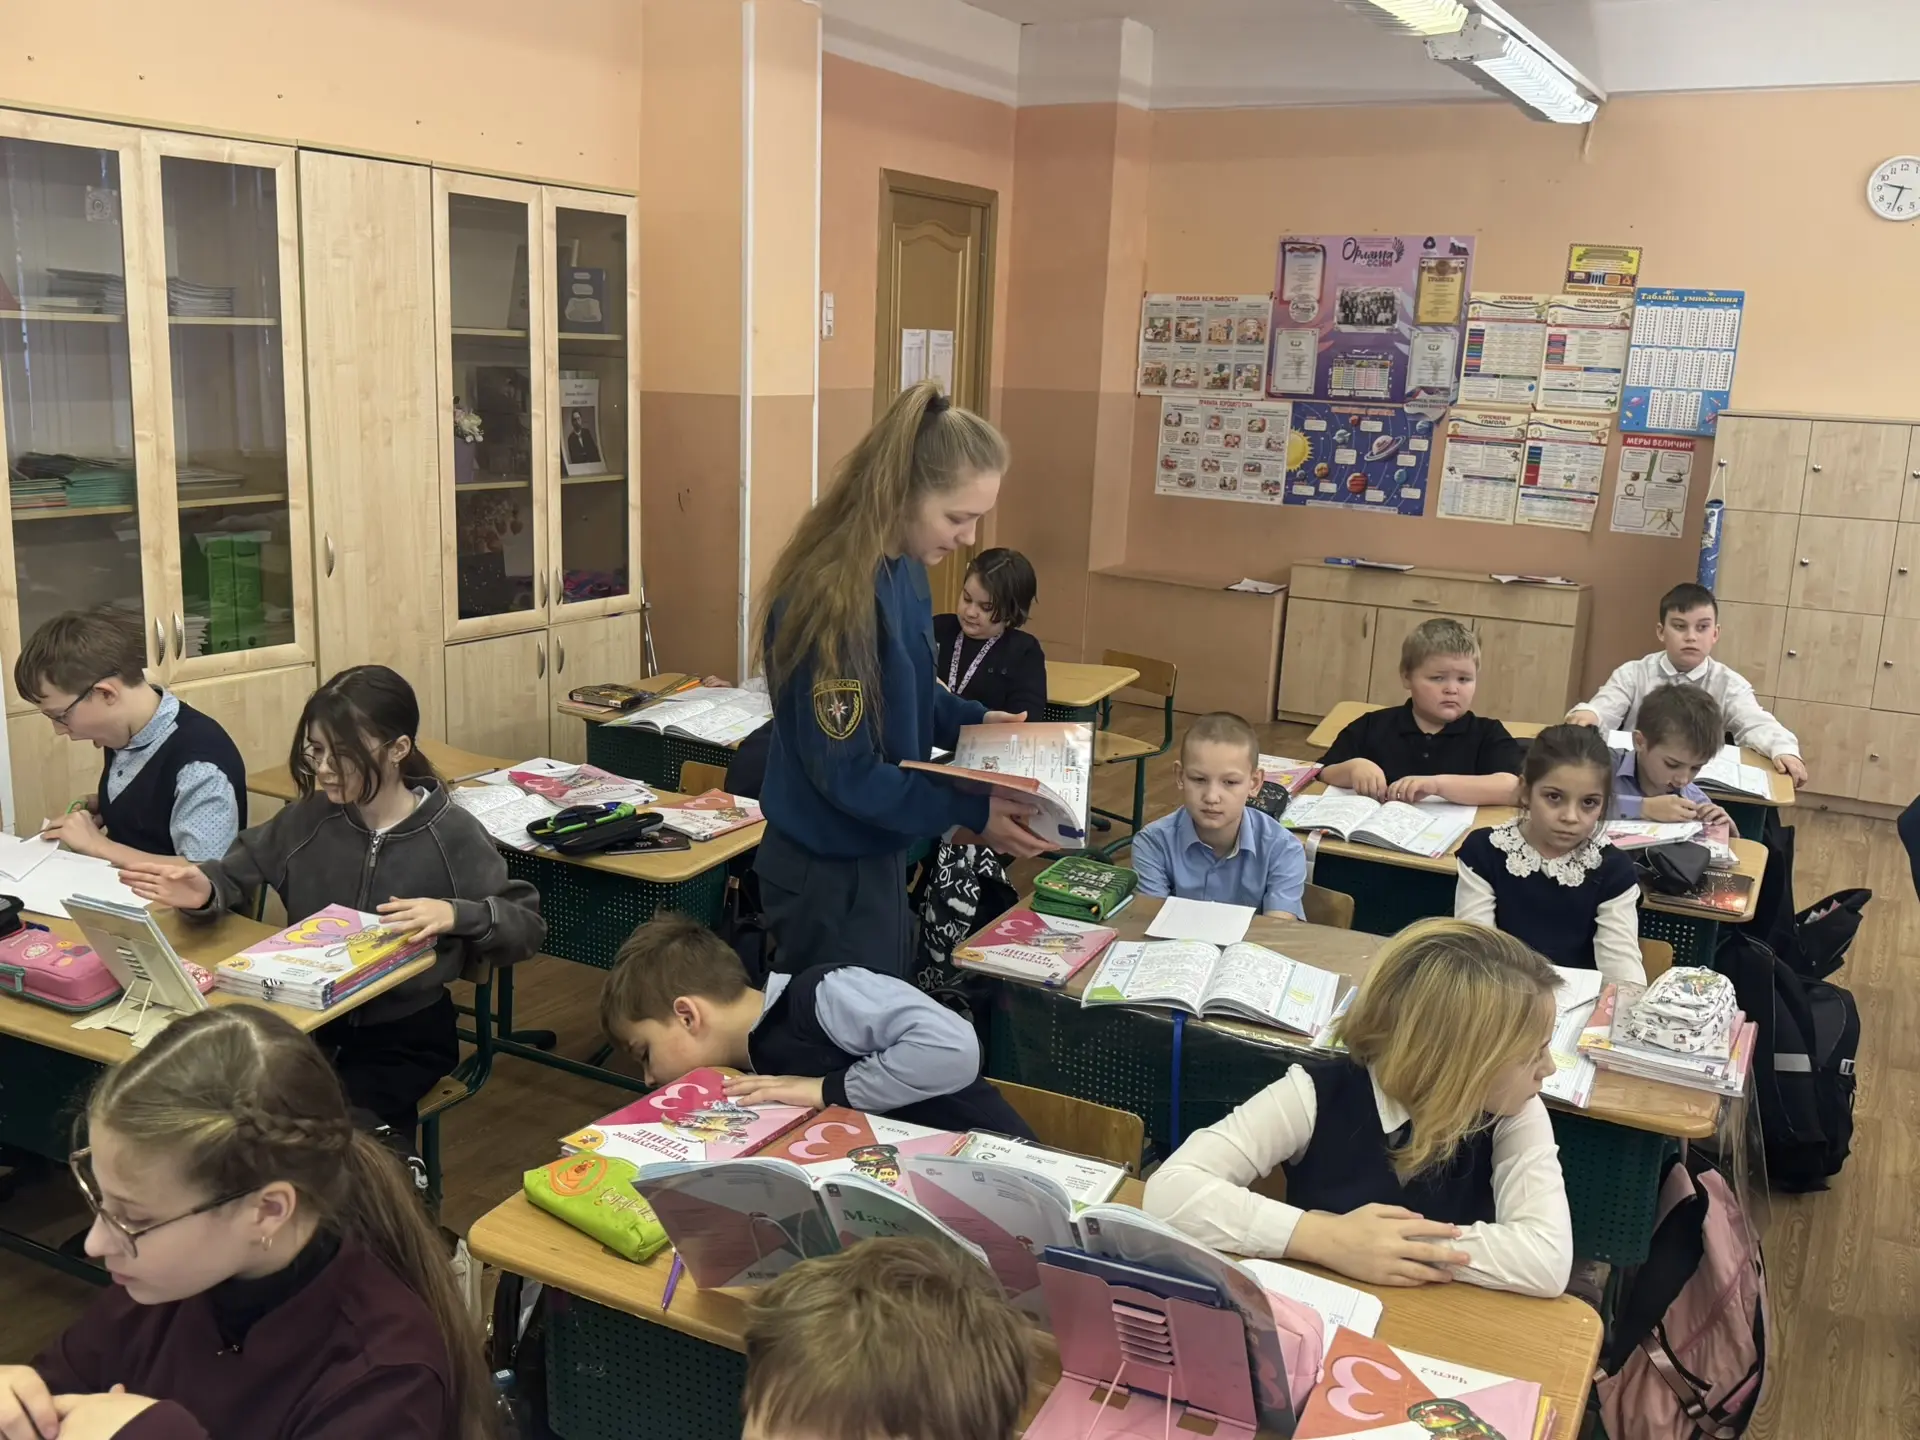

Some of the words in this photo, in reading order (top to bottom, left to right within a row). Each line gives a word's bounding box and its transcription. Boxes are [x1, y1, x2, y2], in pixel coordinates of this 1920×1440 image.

[1640, 291, 1680, 302] Таблица
[1682, 294, 1739, 304] умножения
[1626, 437, 1651, 446] МЕРЫ
[1652, 439, 1692, 449] ВЕЛИЧИН
[994, 918, 1034, 937] 3
[649, 1083, 709, 1110] 3
[637, 1128, 690, 1155] ЧТЕНИЕ
[788, 1121, 861, 1160] 3
[991, 1143, 1013, 1155] Part
[1430, 1370, 1468, 1385] Часть
[1326, 1355, 1402, 1421] 3
